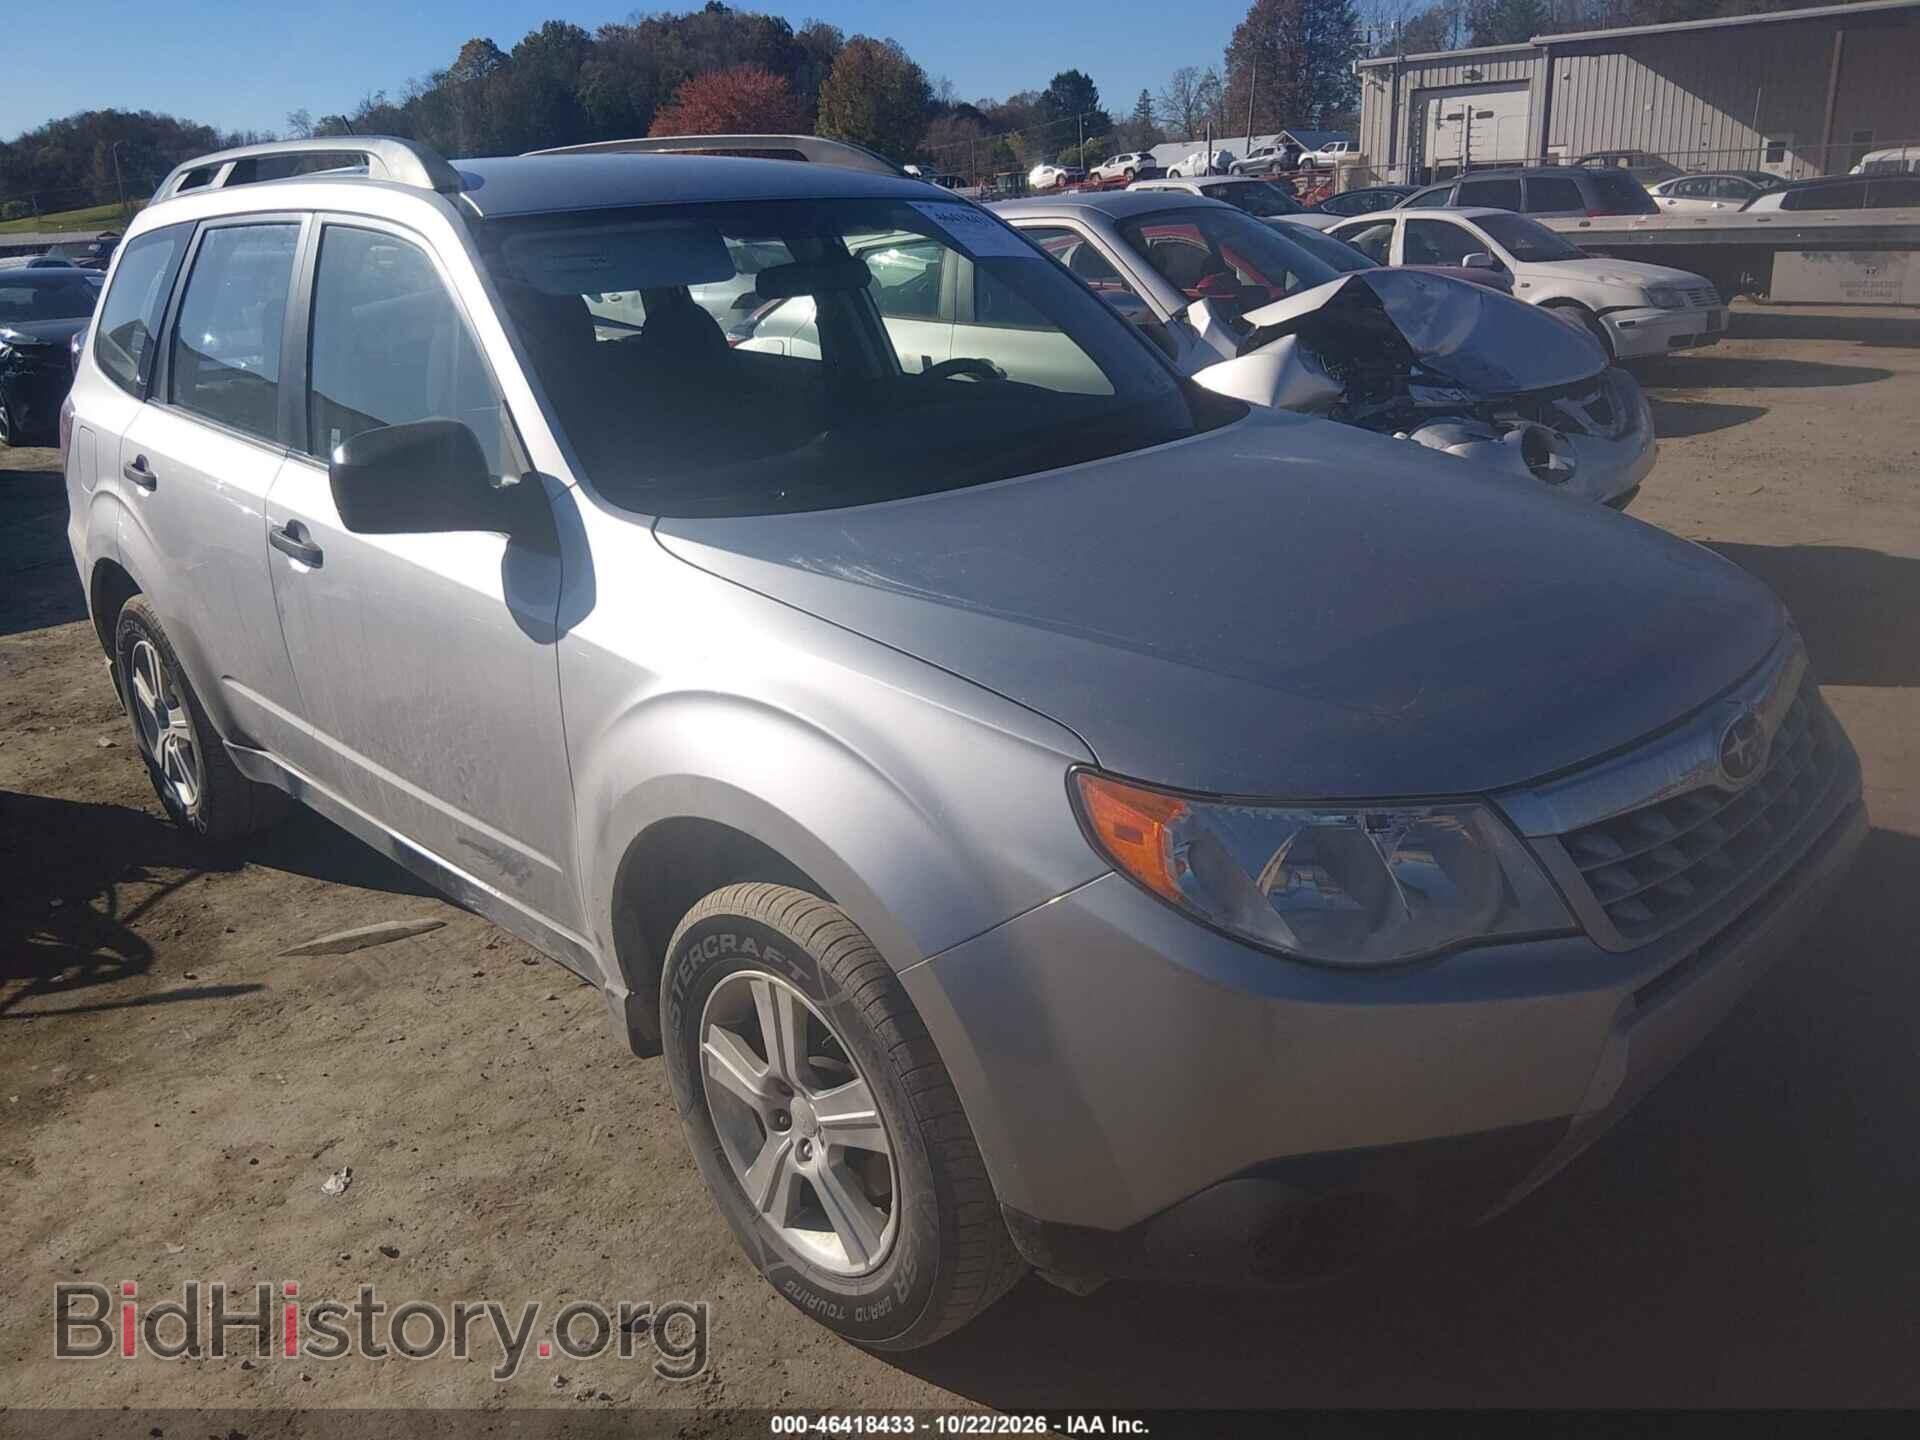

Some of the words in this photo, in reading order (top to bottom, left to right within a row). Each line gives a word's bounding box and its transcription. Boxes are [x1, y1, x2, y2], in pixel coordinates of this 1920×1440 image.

[671, 934, 812, 1034] STERCRAFT
[782, 1280, 846, 1320] TOURING
[854, 1295, 893, 1323] GRAND
